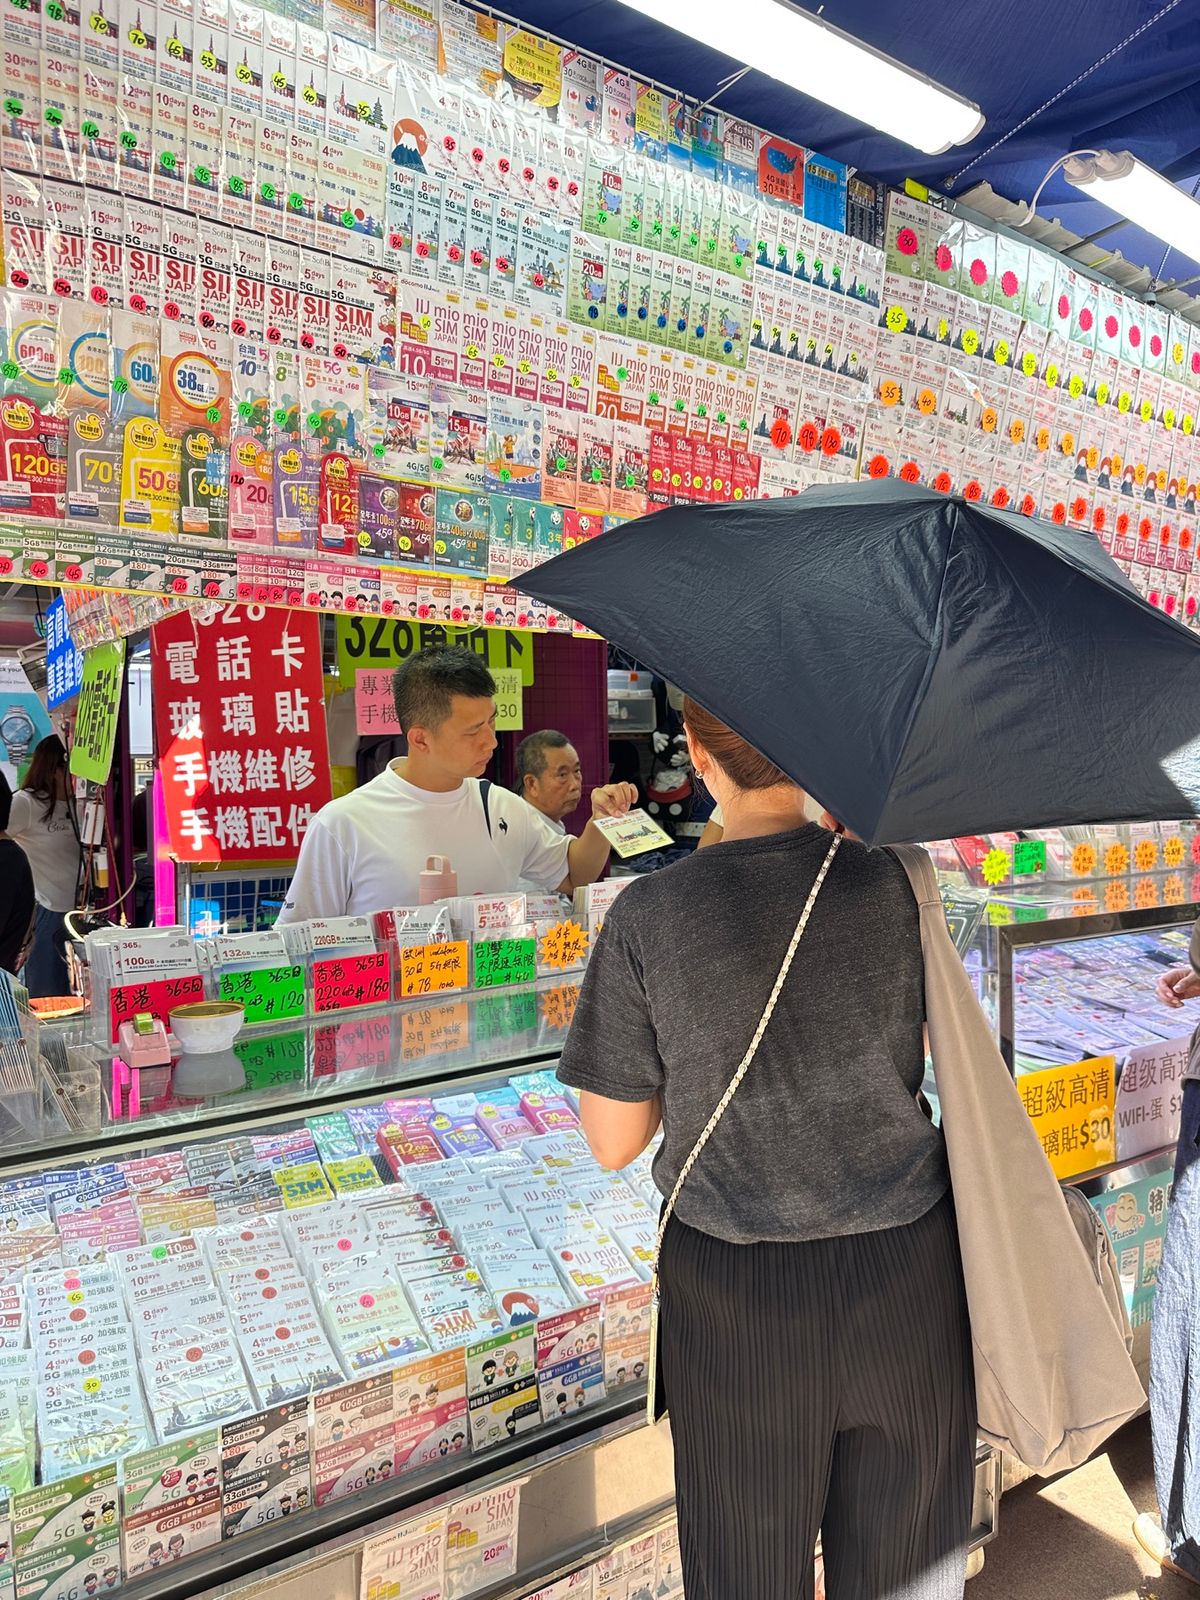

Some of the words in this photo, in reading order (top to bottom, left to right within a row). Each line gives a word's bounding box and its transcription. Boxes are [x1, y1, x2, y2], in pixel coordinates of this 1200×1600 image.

[331, 290, 345, 300] 5G
[335, 304, 373, 329] SIM
[434, 305, 460, 321] mio
[335, 322, 372, 338] JAPAN
[434, 319, 458, 336] SIM
[463, 326, 487, 343] SIM
[434, 332, 458, 344] JAPAN
[626, 359, 648, 373] mio
[626, 370, 645, 385] SIM
[625, 383, 645, 393] JAPAN
[388, 405, 410, 420] 10GB
[449, 417, 470, 433] 15GB
[165, 631, 305, 685] 電話卡
[168, 688, 310, 741] 玻璃貼
[172, 745, 317, 797] 手機維修
[315, 963, 346, 984] 香港
[220, 972, 256, 995] 香港
[112, 986, 154, 1014] 香港
[1022, 1067, 1110, 1119] 超級高清
[255, 1454, 273, 1467] 5G
[161, 1486, 181, 1500] 5G
[486, 1501, 514, 1524] SIM
[53, 1525, 76, 1542] 5G
[485, 1517, 513, 1535] JAPAN
[408, 1551, 440, 1574] SIM
[408, 1564, 440, 1583] JAPAN
